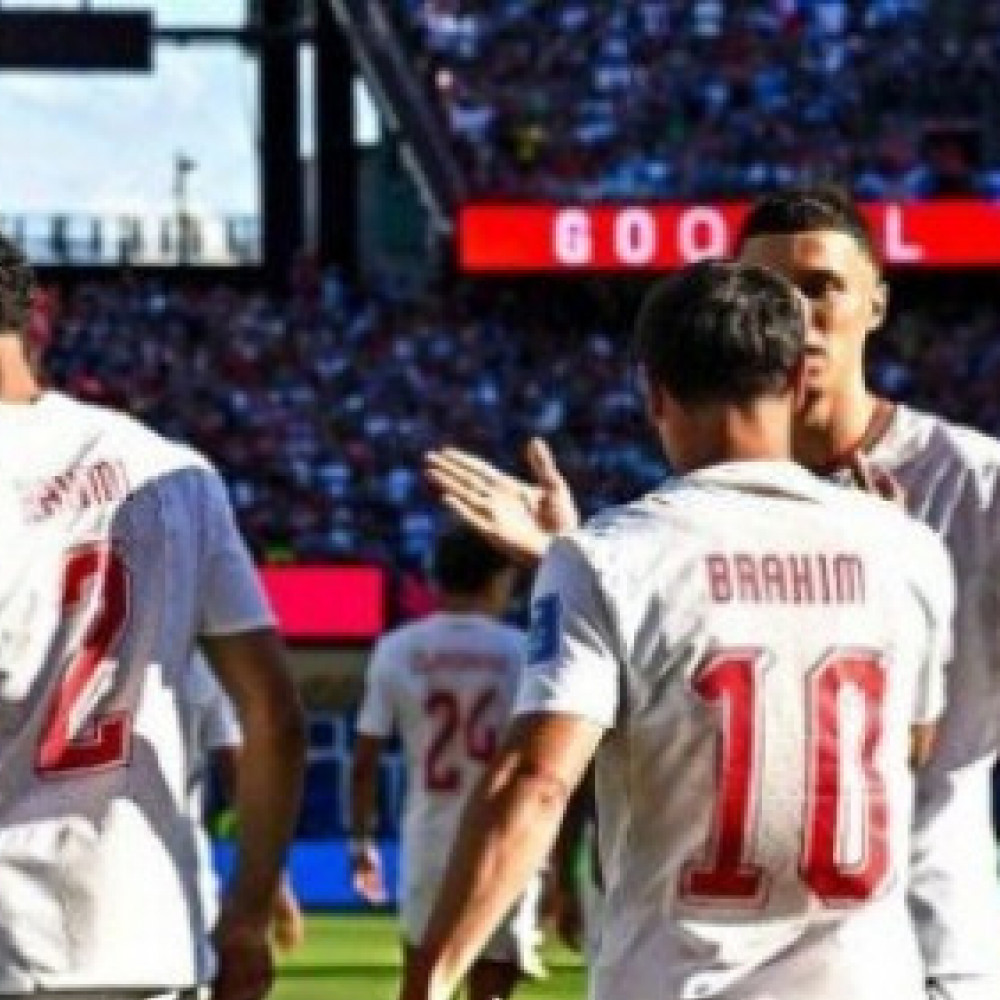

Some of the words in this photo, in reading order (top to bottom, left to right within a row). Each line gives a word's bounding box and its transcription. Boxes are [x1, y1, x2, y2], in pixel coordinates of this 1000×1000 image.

[554, 205, 926, 265] GOOL
[705, 552, 866, 605] BRAHIM
[34, 541, 133, 779] 2
[679, 646, 893, 908] 10
